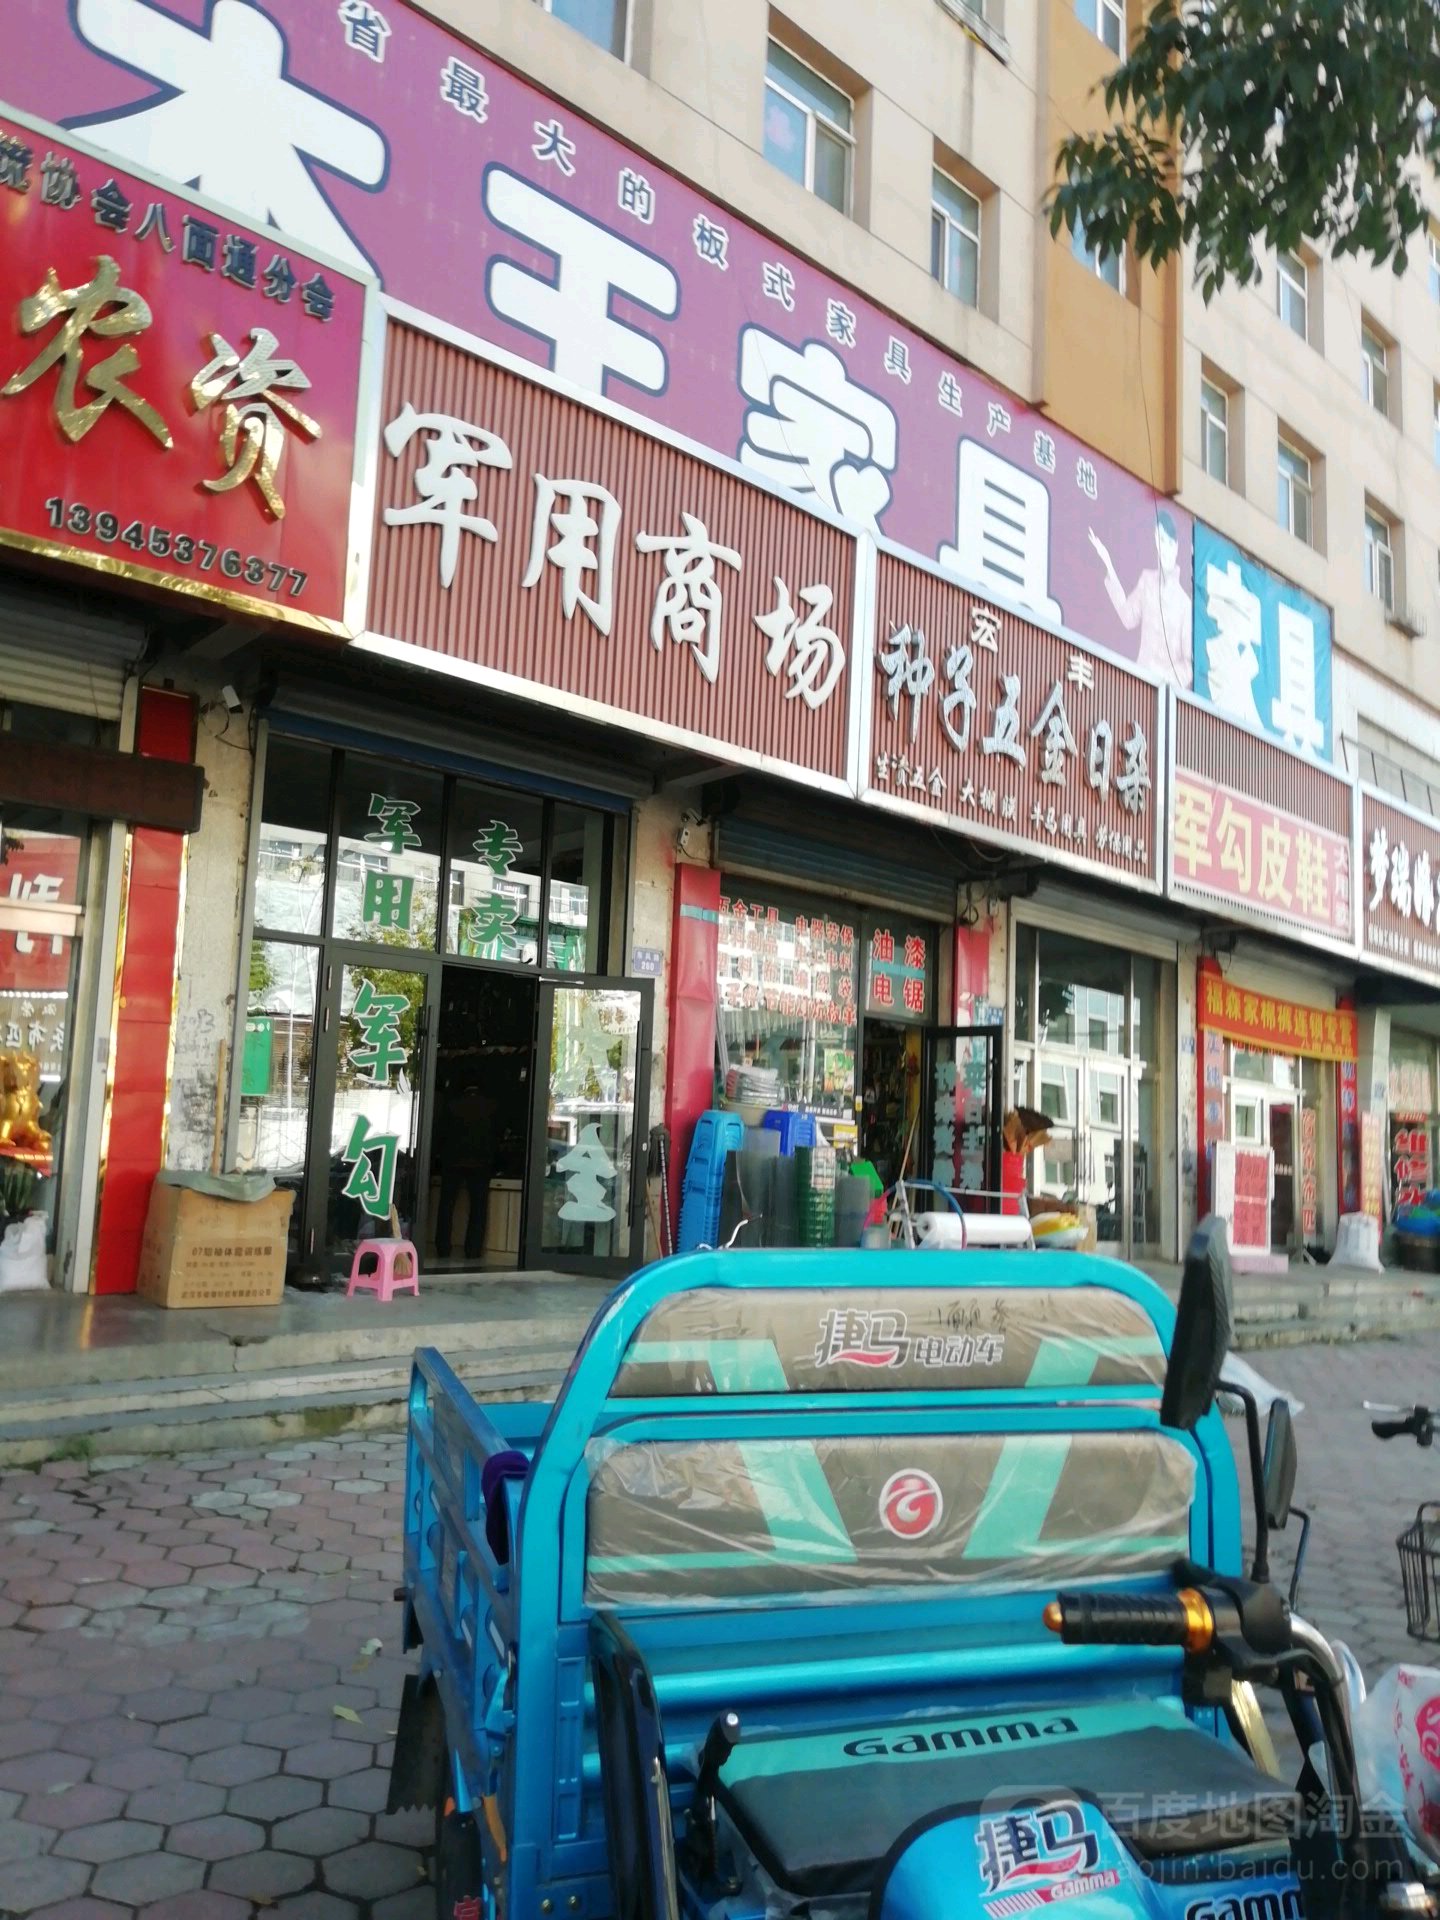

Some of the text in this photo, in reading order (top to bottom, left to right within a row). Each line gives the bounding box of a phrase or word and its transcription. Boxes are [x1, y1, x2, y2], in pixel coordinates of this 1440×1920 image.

[1, 254, 323, 520] 农资
[45, 495, 308, 597] 13945376377
[382, 401, 847, 711] 军用商场
[970, 607, 1095, 692] 宏丰
[1203, 560, 1326, 760] 家具
[876, 622, 1152, 816] 种子五金日杂
[362, 793, 423, 931] 军用
[472, 820, 523, 949] 专卖
[1174, 782, 1331, 921] 军勾皮鞋
[873, 928, 926, 969] 油漆
[873, 973, 925, 1013] 电锯
[341, 979, 411, 1221] 军勾
[815, 1309, 912, 1368] 捷马
[914, 1335, 1005, 1367] 电动车
[843, 1715, 1079, 1758] Gamma
[973, 1800, 1101, 1894] 捷马
[1050, 1869, 1118, 1900] Gamma
